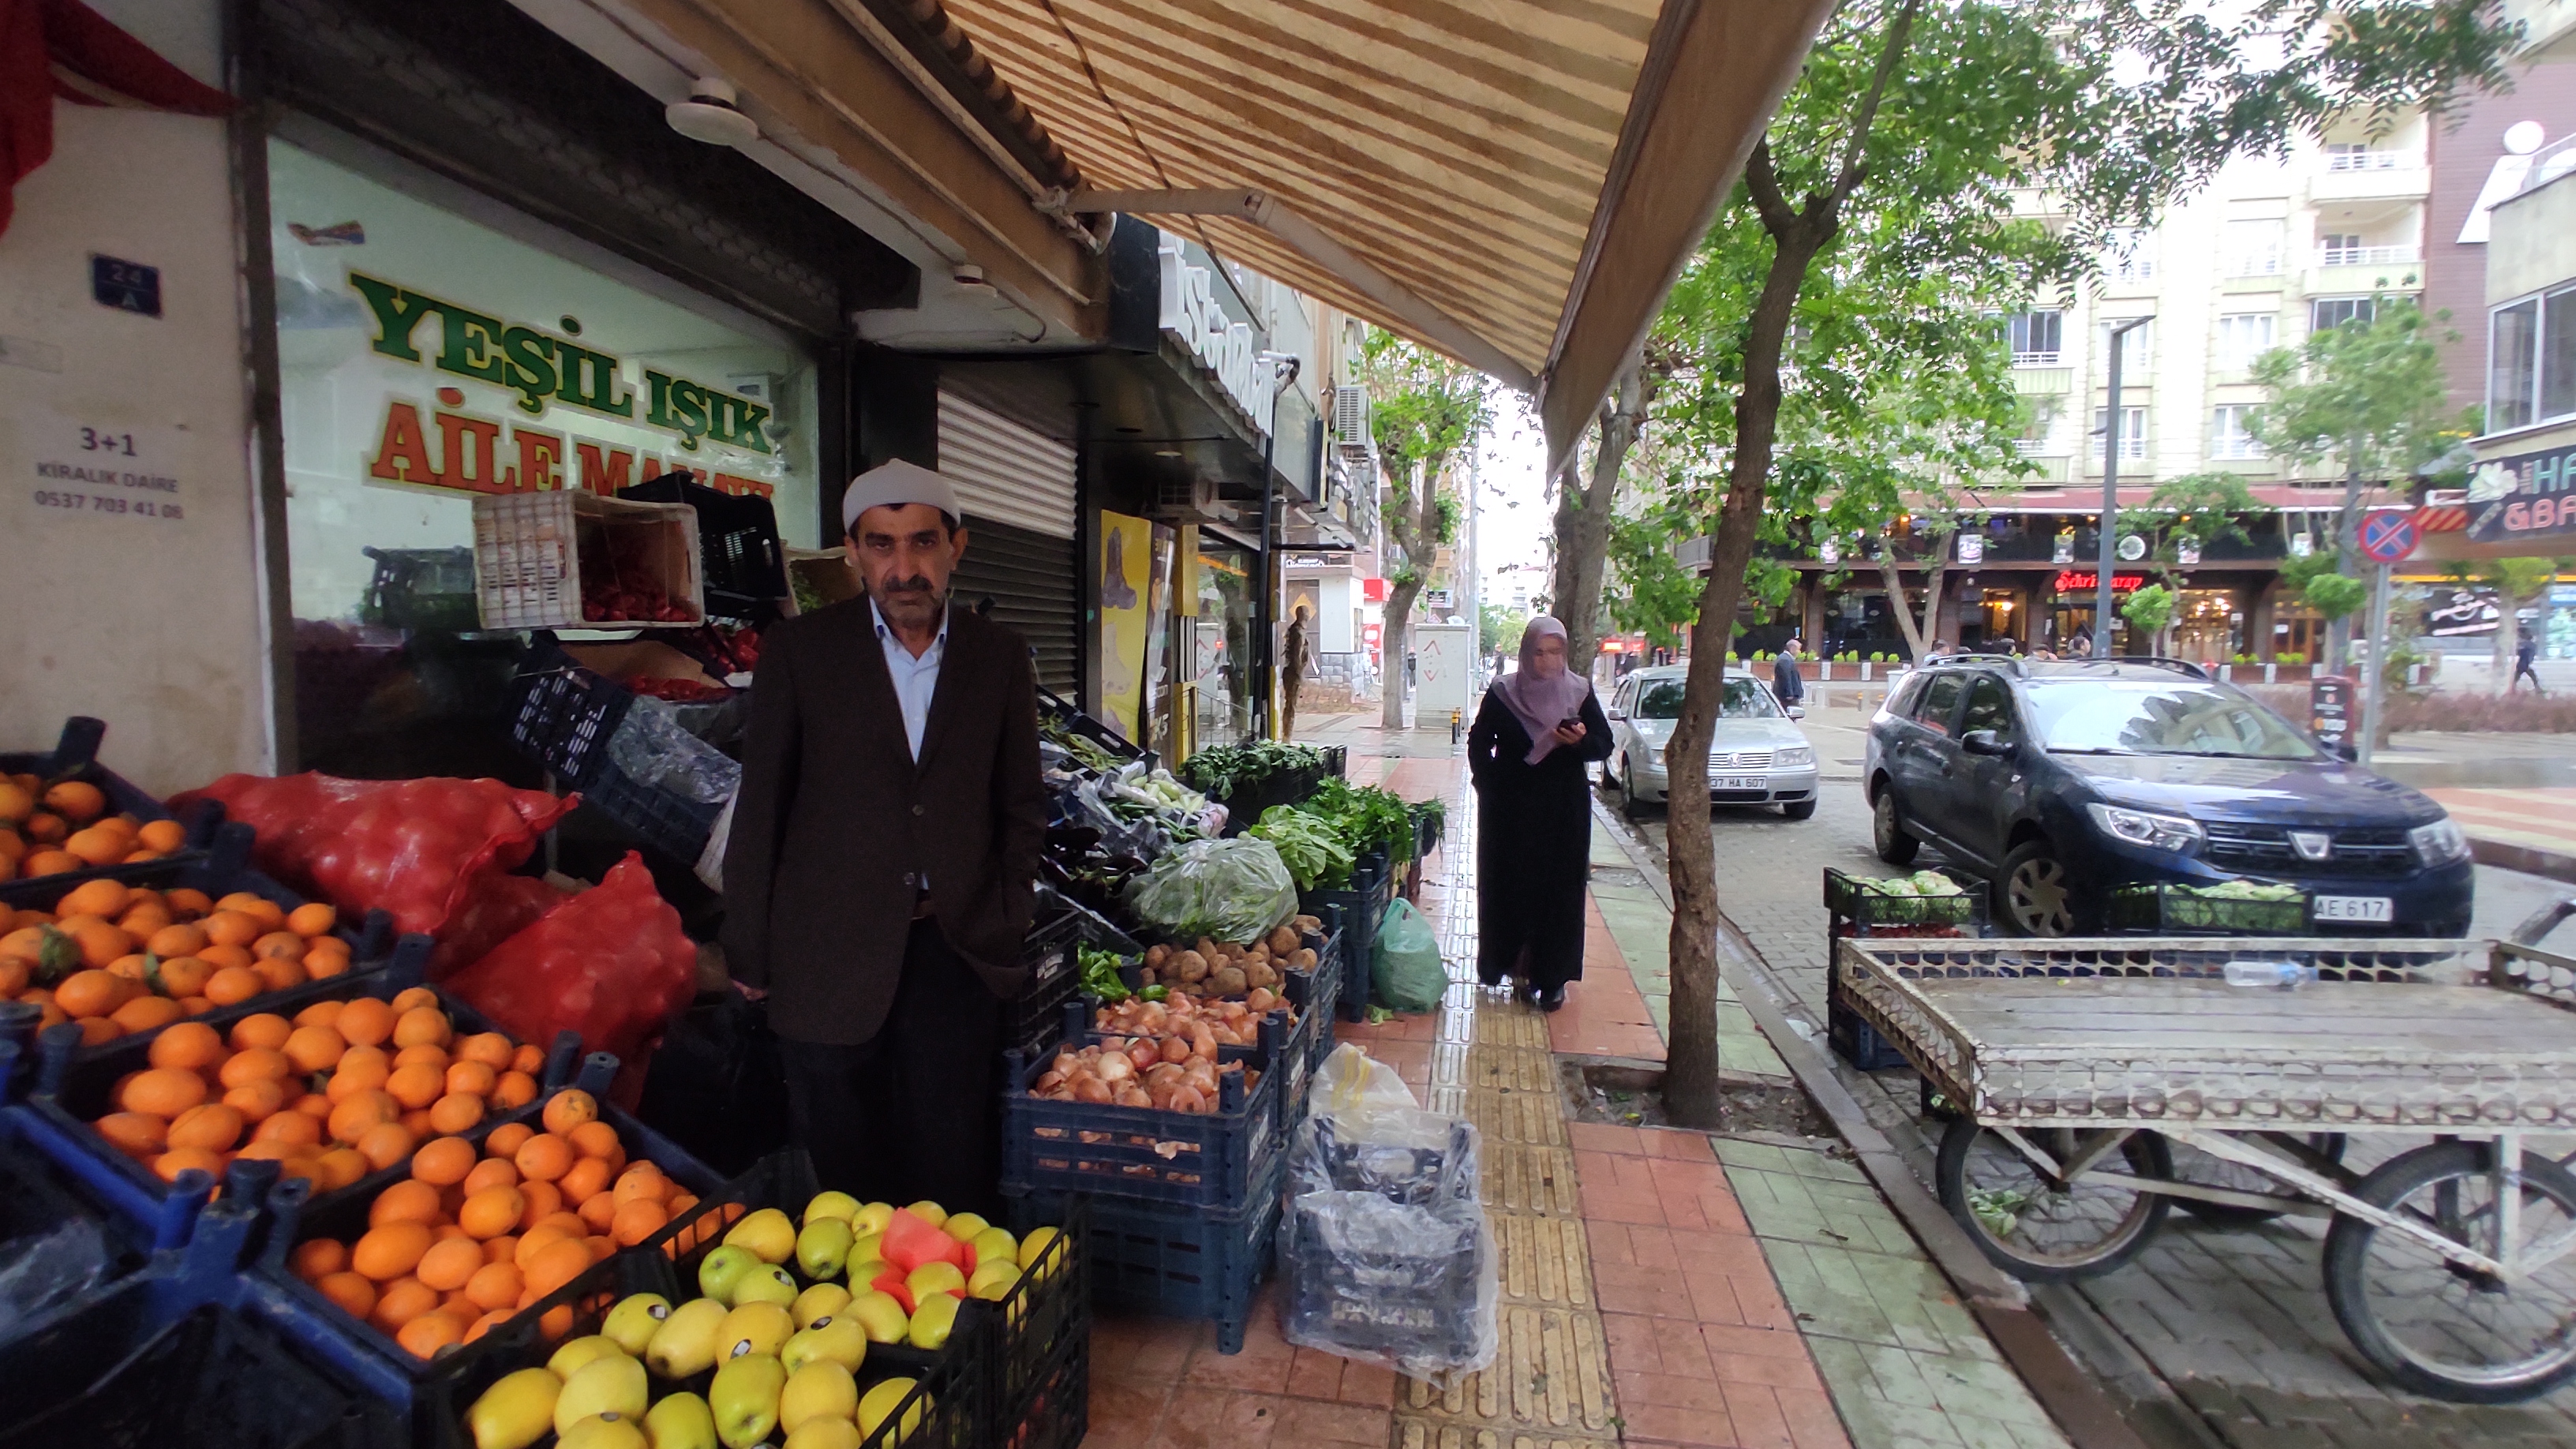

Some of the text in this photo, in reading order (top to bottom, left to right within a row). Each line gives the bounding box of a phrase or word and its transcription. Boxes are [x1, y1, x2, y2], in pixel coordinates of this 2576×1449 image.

[121, 293, 140, 309] A
[350, 273, 774, 454] YEŞİL IŞIK
[80, 427, 137, 457] 3+1
[371, 387, 561, 495] AİLE
[35, 490, 86, 509] 0537
[93, 496, 127, 514] 703
[1728, 778, 1742, 788] HA
[1745, 778, 1765, 788] 607
[2316, 900, 2383, 918] AE 617
